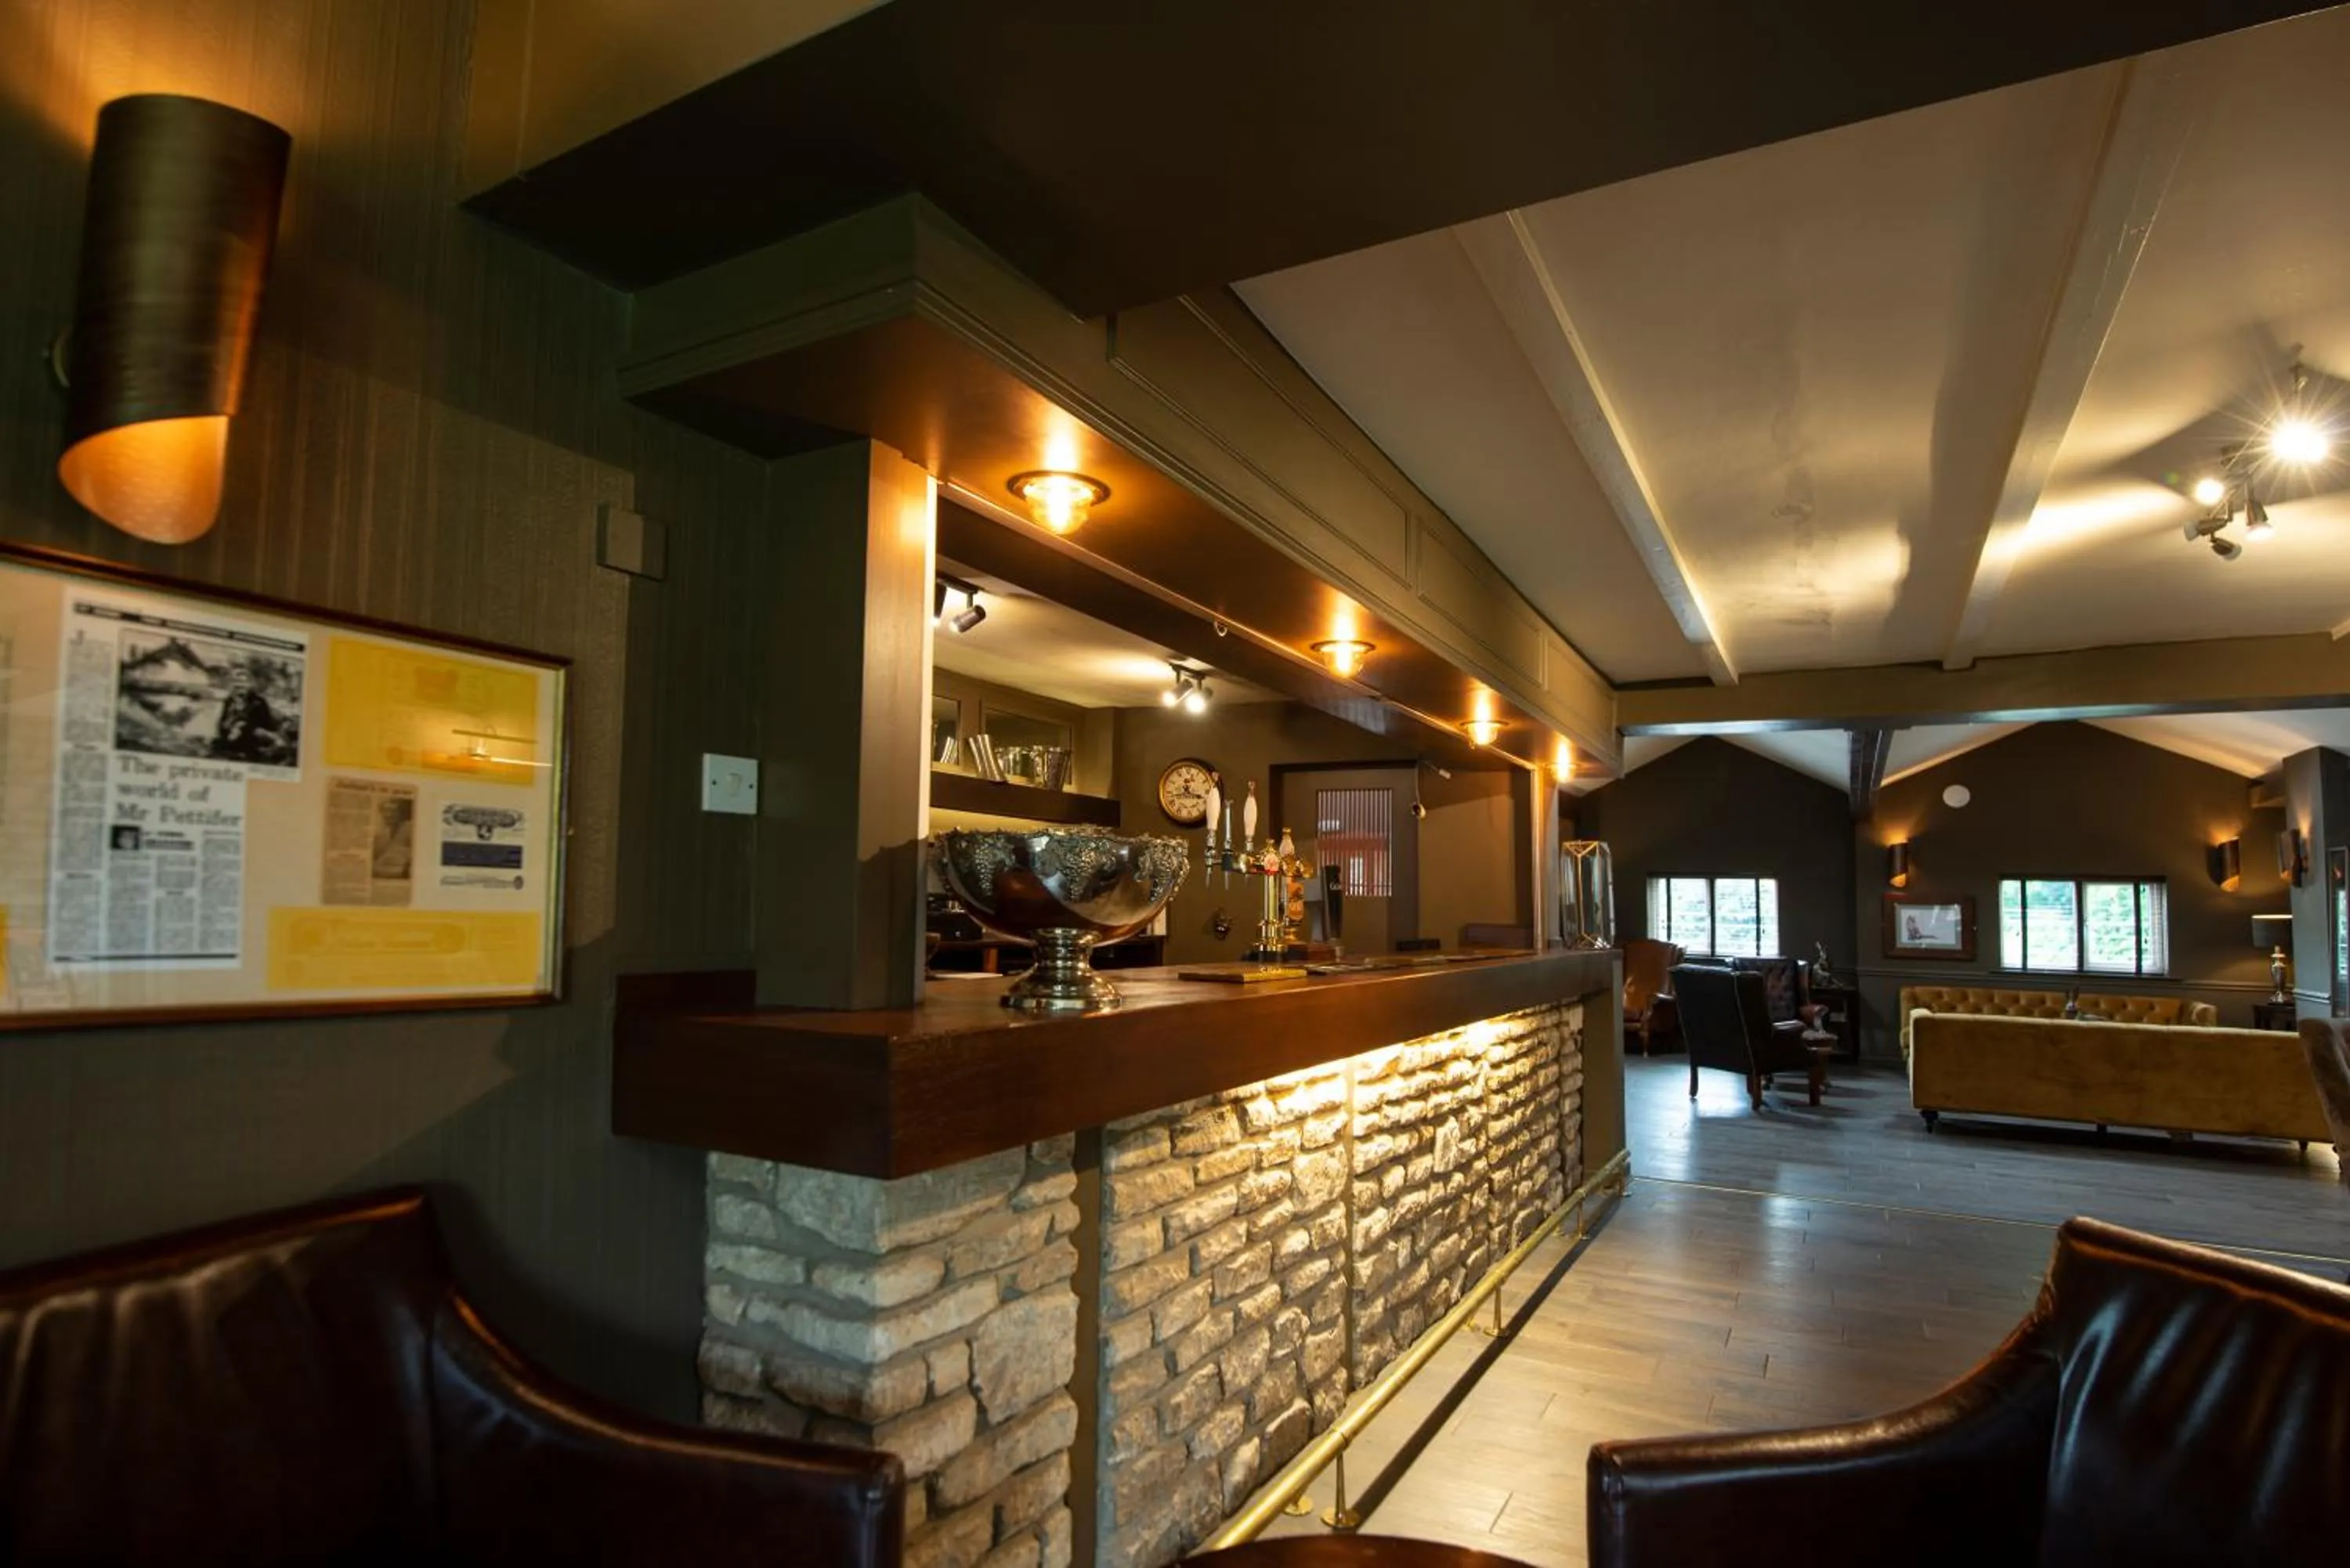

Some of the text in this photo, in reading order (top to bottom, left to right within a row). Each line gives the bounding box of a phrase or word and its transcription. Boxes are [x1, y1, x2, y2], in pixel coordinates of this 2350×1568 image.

[118, 754, 161, 774] The
[168, 761, 244, 782] private
[117, 782, 210, 802] world of
[115, 803, 151, 821] Mr
